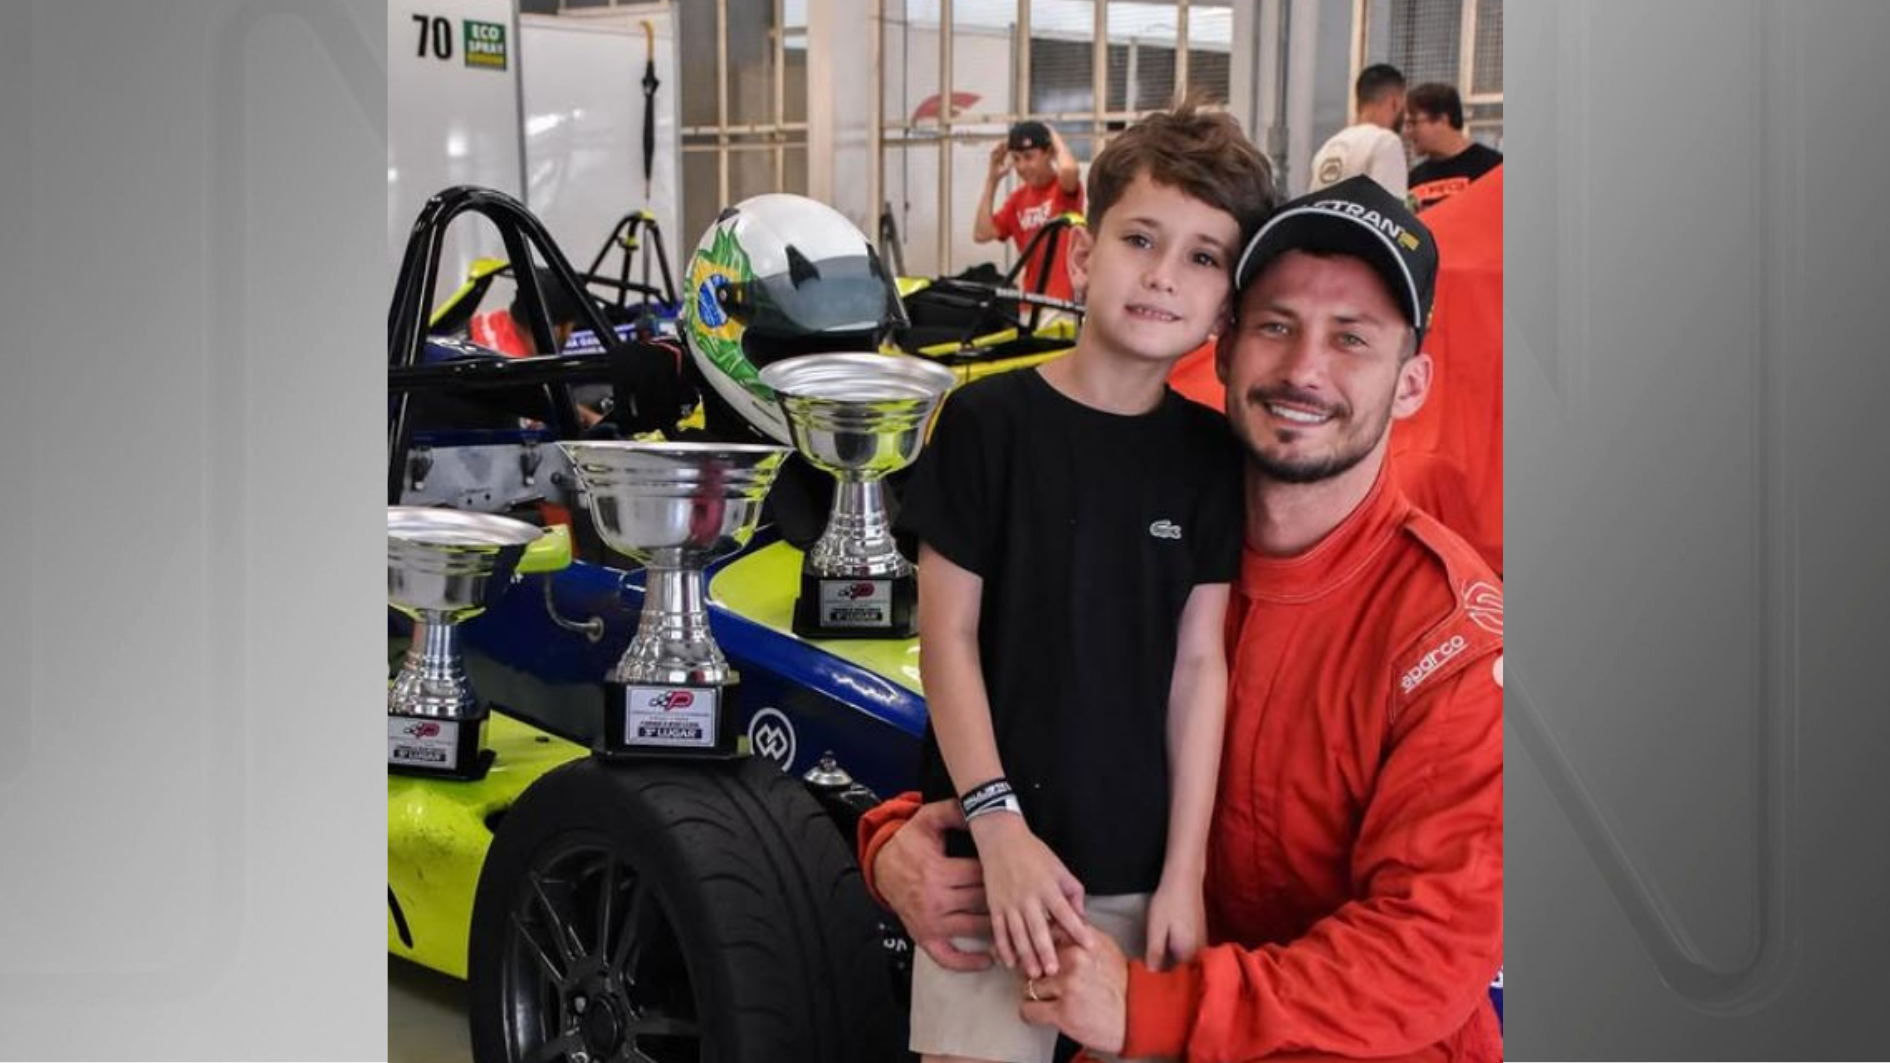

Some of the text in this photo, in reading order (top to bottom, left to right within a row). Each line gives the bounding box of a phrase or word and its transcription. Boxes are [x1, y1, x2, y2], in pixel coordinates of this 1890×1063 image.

[411, 13, 453, 60] 70
[471, 24, 500, 41] ECO
[468, 40, 505, 55] SPRAY
[658, 727, 697, 738] LUGAR
